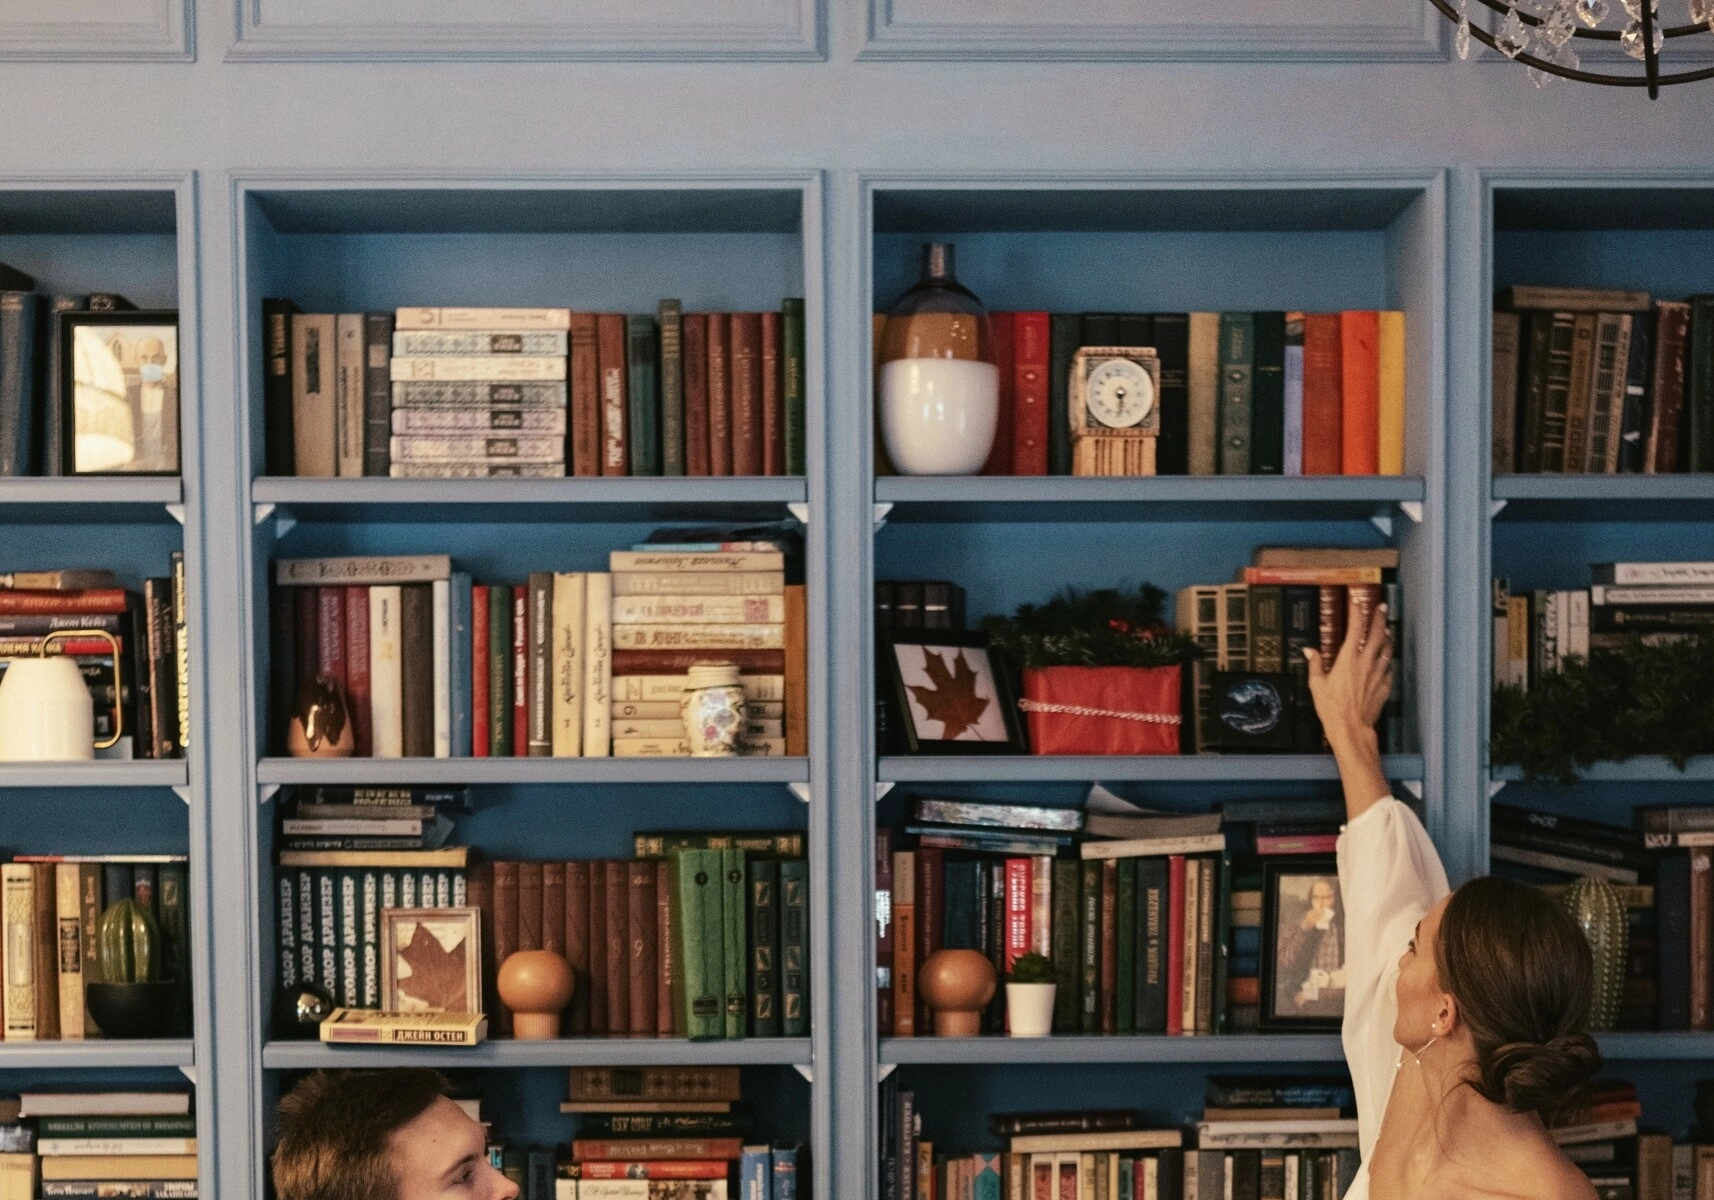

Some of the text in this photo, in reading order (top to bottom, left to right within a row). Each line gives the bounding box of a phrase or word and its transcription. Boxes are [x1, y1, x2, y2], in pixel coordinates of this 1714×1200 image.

[321, 876, 336, 946] ДРАЙЗЕР
[343, 876, 356, 946] ДРАЙЗЕР
[364, 873, 377, 1006] ТЕОДОР ДРАЙЗЕР
[634, 939, 644, 958] 9
[396, 1029, 464, 1042] ДЖЕЙН ОСТЕН
